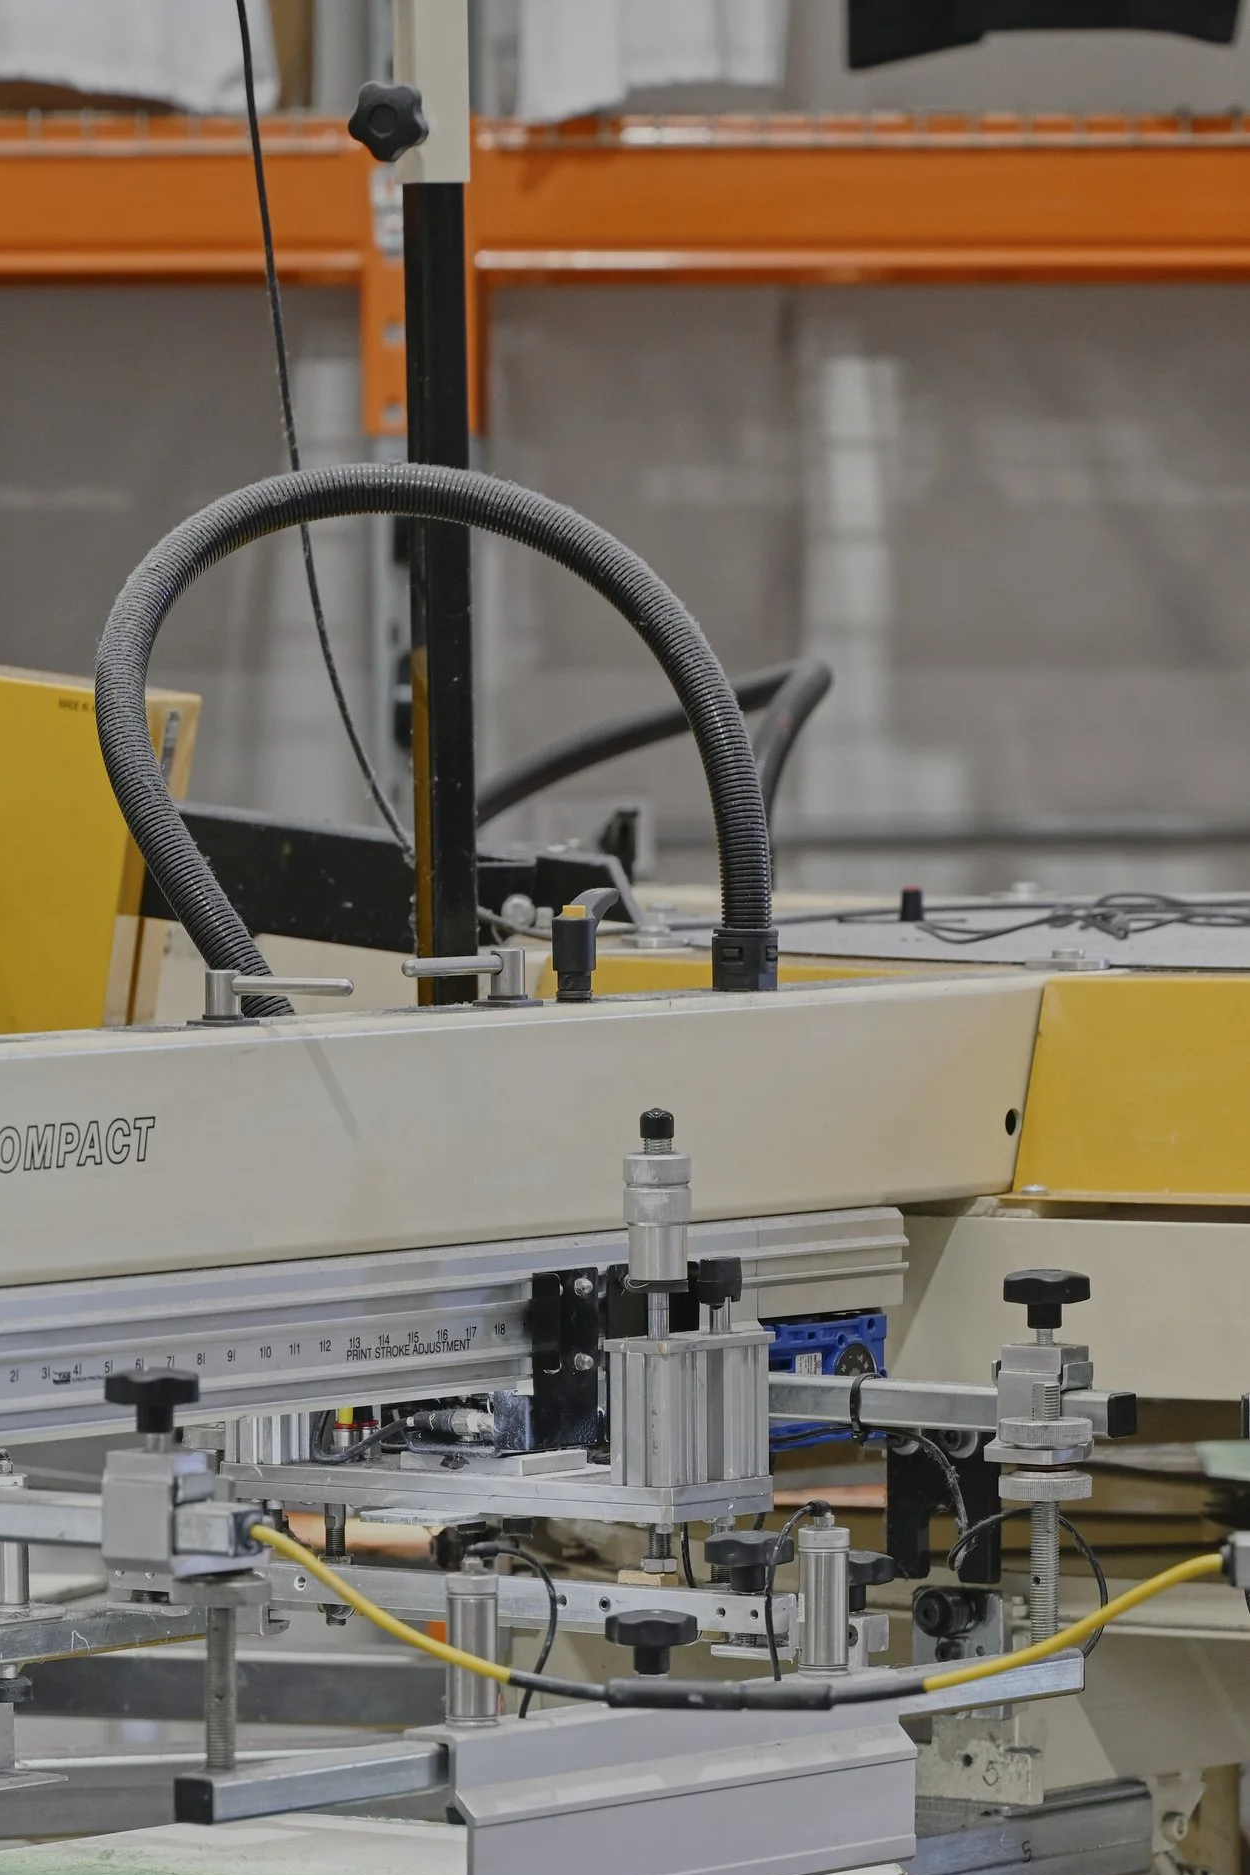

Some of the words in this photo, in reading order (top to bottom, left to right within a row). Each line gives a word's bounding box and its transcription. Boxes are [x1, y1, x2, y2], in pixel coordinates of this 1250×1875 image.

[346, 1347, 373, 1362] PRINT
[374, 1344, 411, 1359] STROKE
[412, 1338, 472, 1355] ADJUSTMENT
